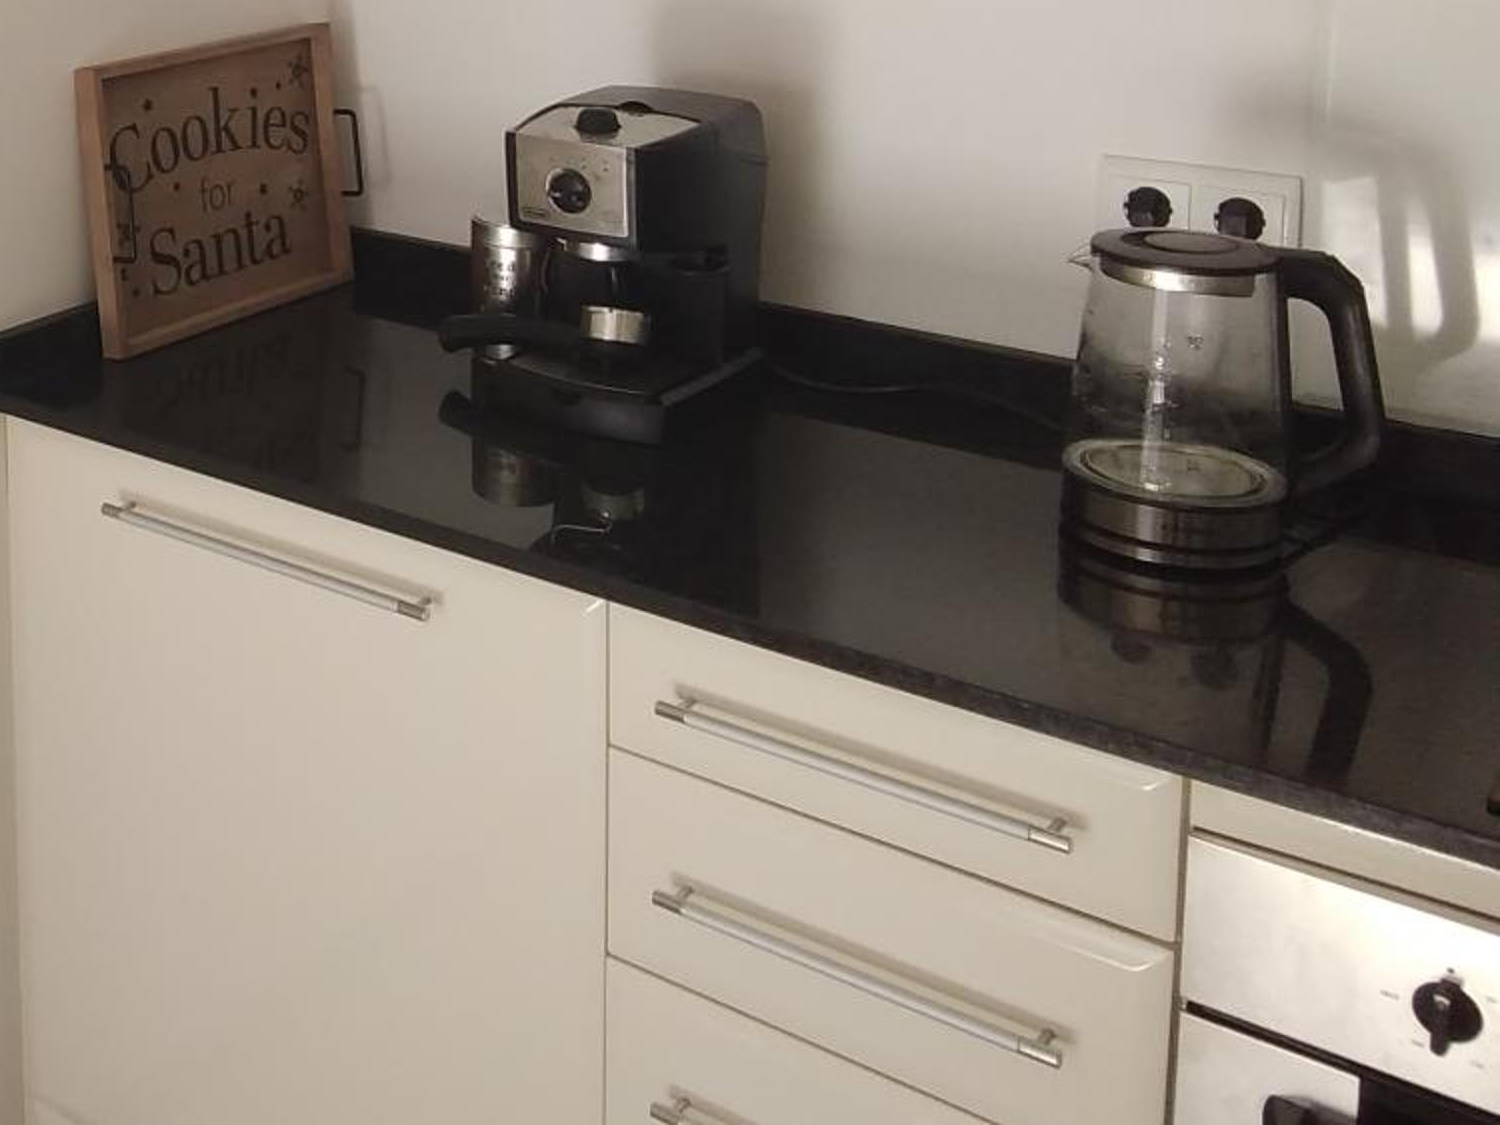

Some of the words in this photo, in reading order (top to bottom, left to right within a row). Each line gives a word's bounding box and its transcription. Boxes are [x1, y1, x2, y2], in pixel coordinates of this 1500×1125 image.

[109, 87, 311, 194] Cookies
[200, 175, 235, 213] for
[150, 211, 293, 297] Santa
